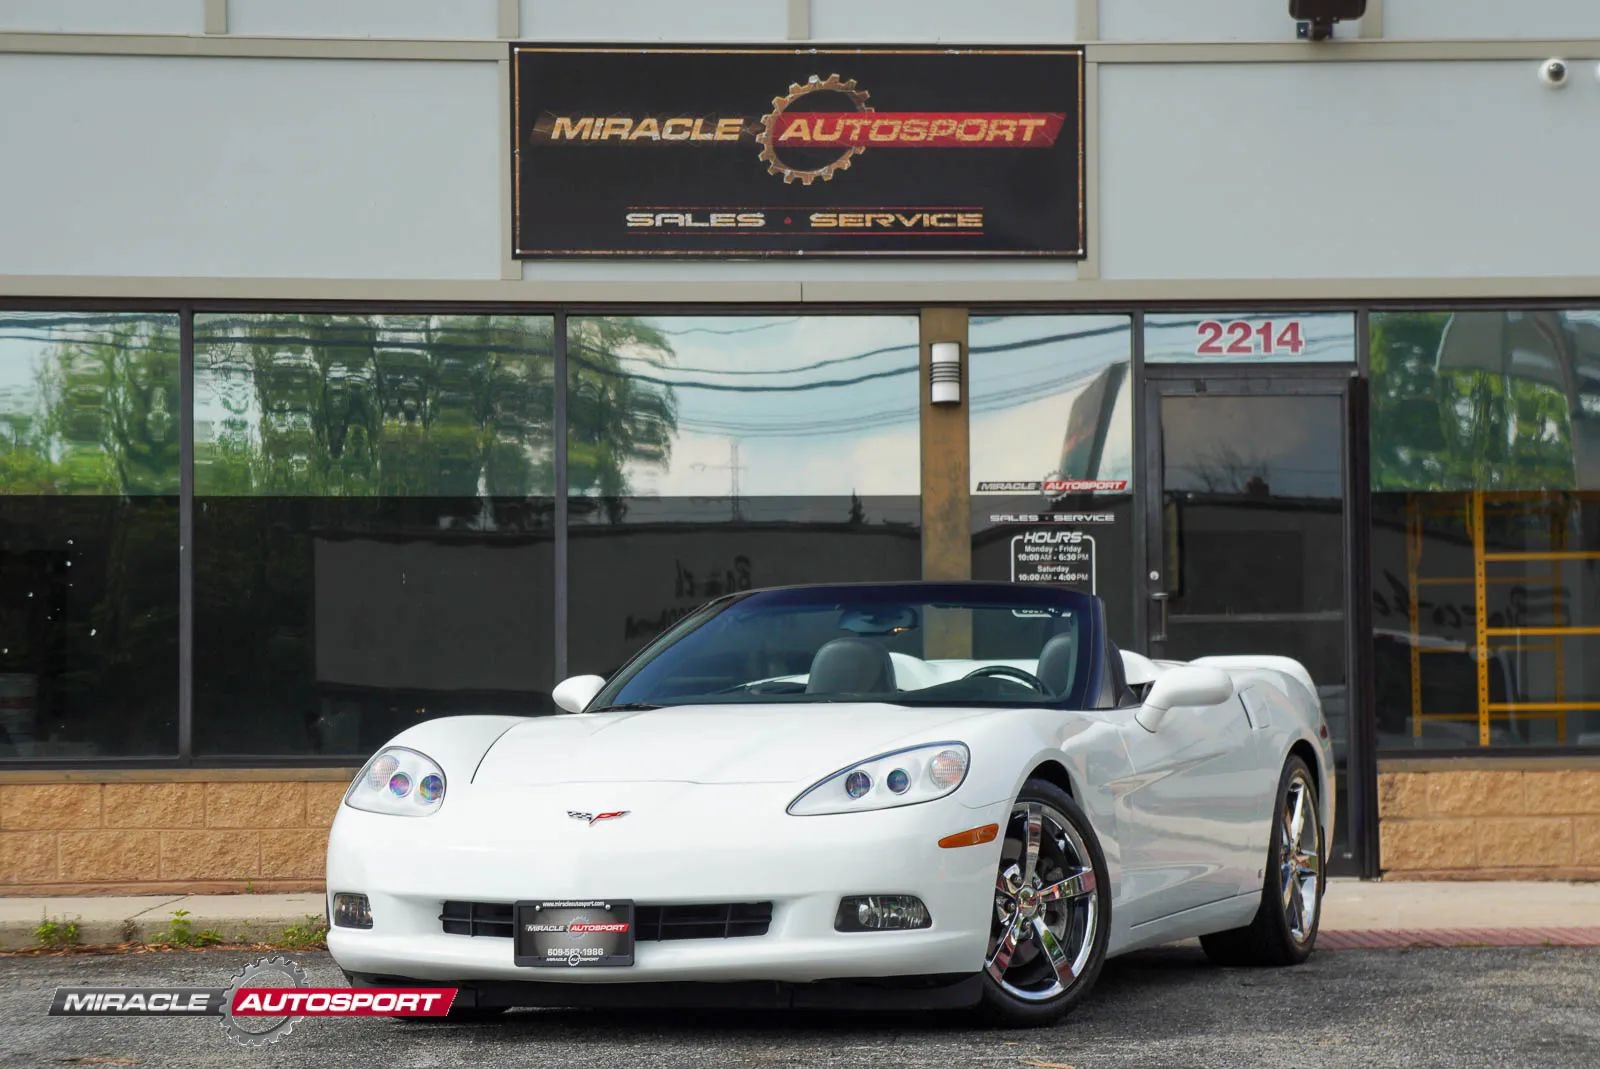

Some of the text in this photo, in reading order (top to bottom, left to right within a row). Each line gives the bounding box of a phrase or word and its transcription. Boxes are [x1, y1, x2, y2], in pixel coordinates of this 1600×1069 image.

[550, 117, 1048, 143] MIRACLE AUTOSPORT
[625, 212, 984, 228] SALES SERVICE
[1196, 320, 1304, 355] 2214
[980, 481, 1123, 491] MIRACLE AUTOSPORT
[990, 514, 1115, 522] SALES SERVICE
[1024, 531, 1083, 544] HOURS
[1024, 545, 1053, 554] Monday
[1059, 545, 1082, 554] Friday
[1018, 553, 1040, 561] 10:00
[1040, 553, 1052, 561] AM
[1077, 553, 1089, 561] PM
[1037, 565, 1069, 574] Saturday
[1018, 573, 1040, 581] 10:00
[1040, 573, 1052, 581] AM
[1077, 573, 1089, 581] PM
[571, 924, 625, 932] AUTOSPORT
